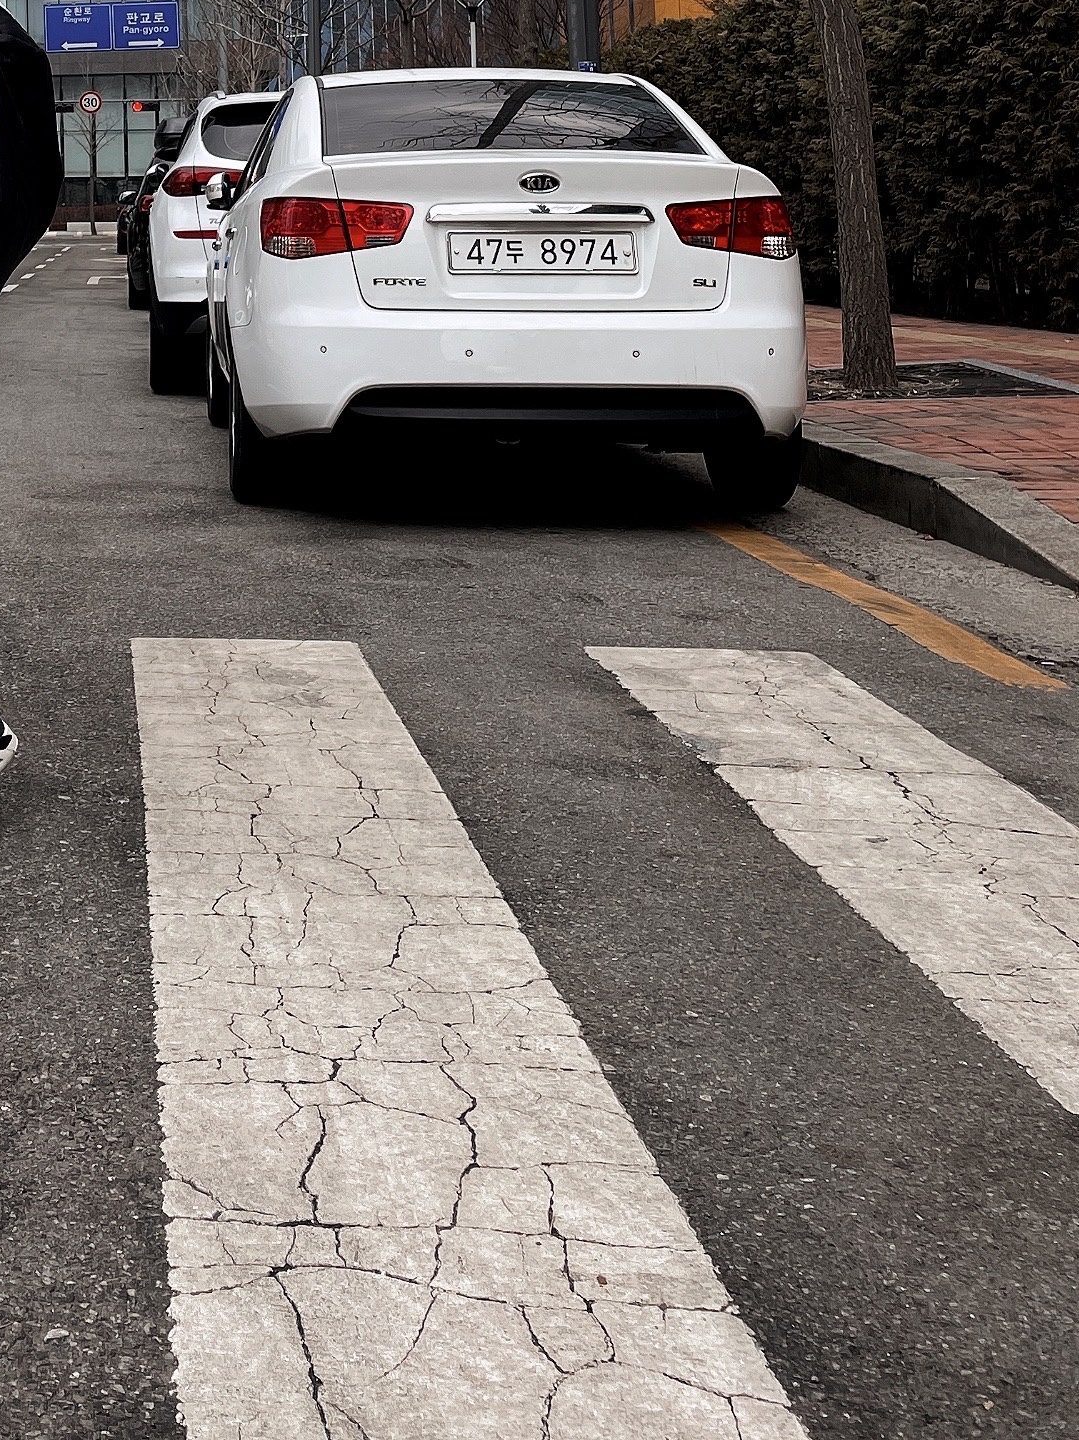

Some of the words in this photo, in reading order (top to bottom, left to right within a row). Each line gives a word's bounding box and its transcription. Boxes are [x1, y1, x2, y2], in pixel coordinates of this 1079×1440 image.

[63, 16, 91, 24] Ringway
[126, 12, 166, 25] 판교로
[123, 25, 169, 35] Pan-gyoro
[83, 97, 97, 108] 30
[526, 177, 553, 189] KIA
[466, 238, 524, 265] 47두
[540, 238, 618, 265] 8974
[372, 277, 426, 287] FORTE
